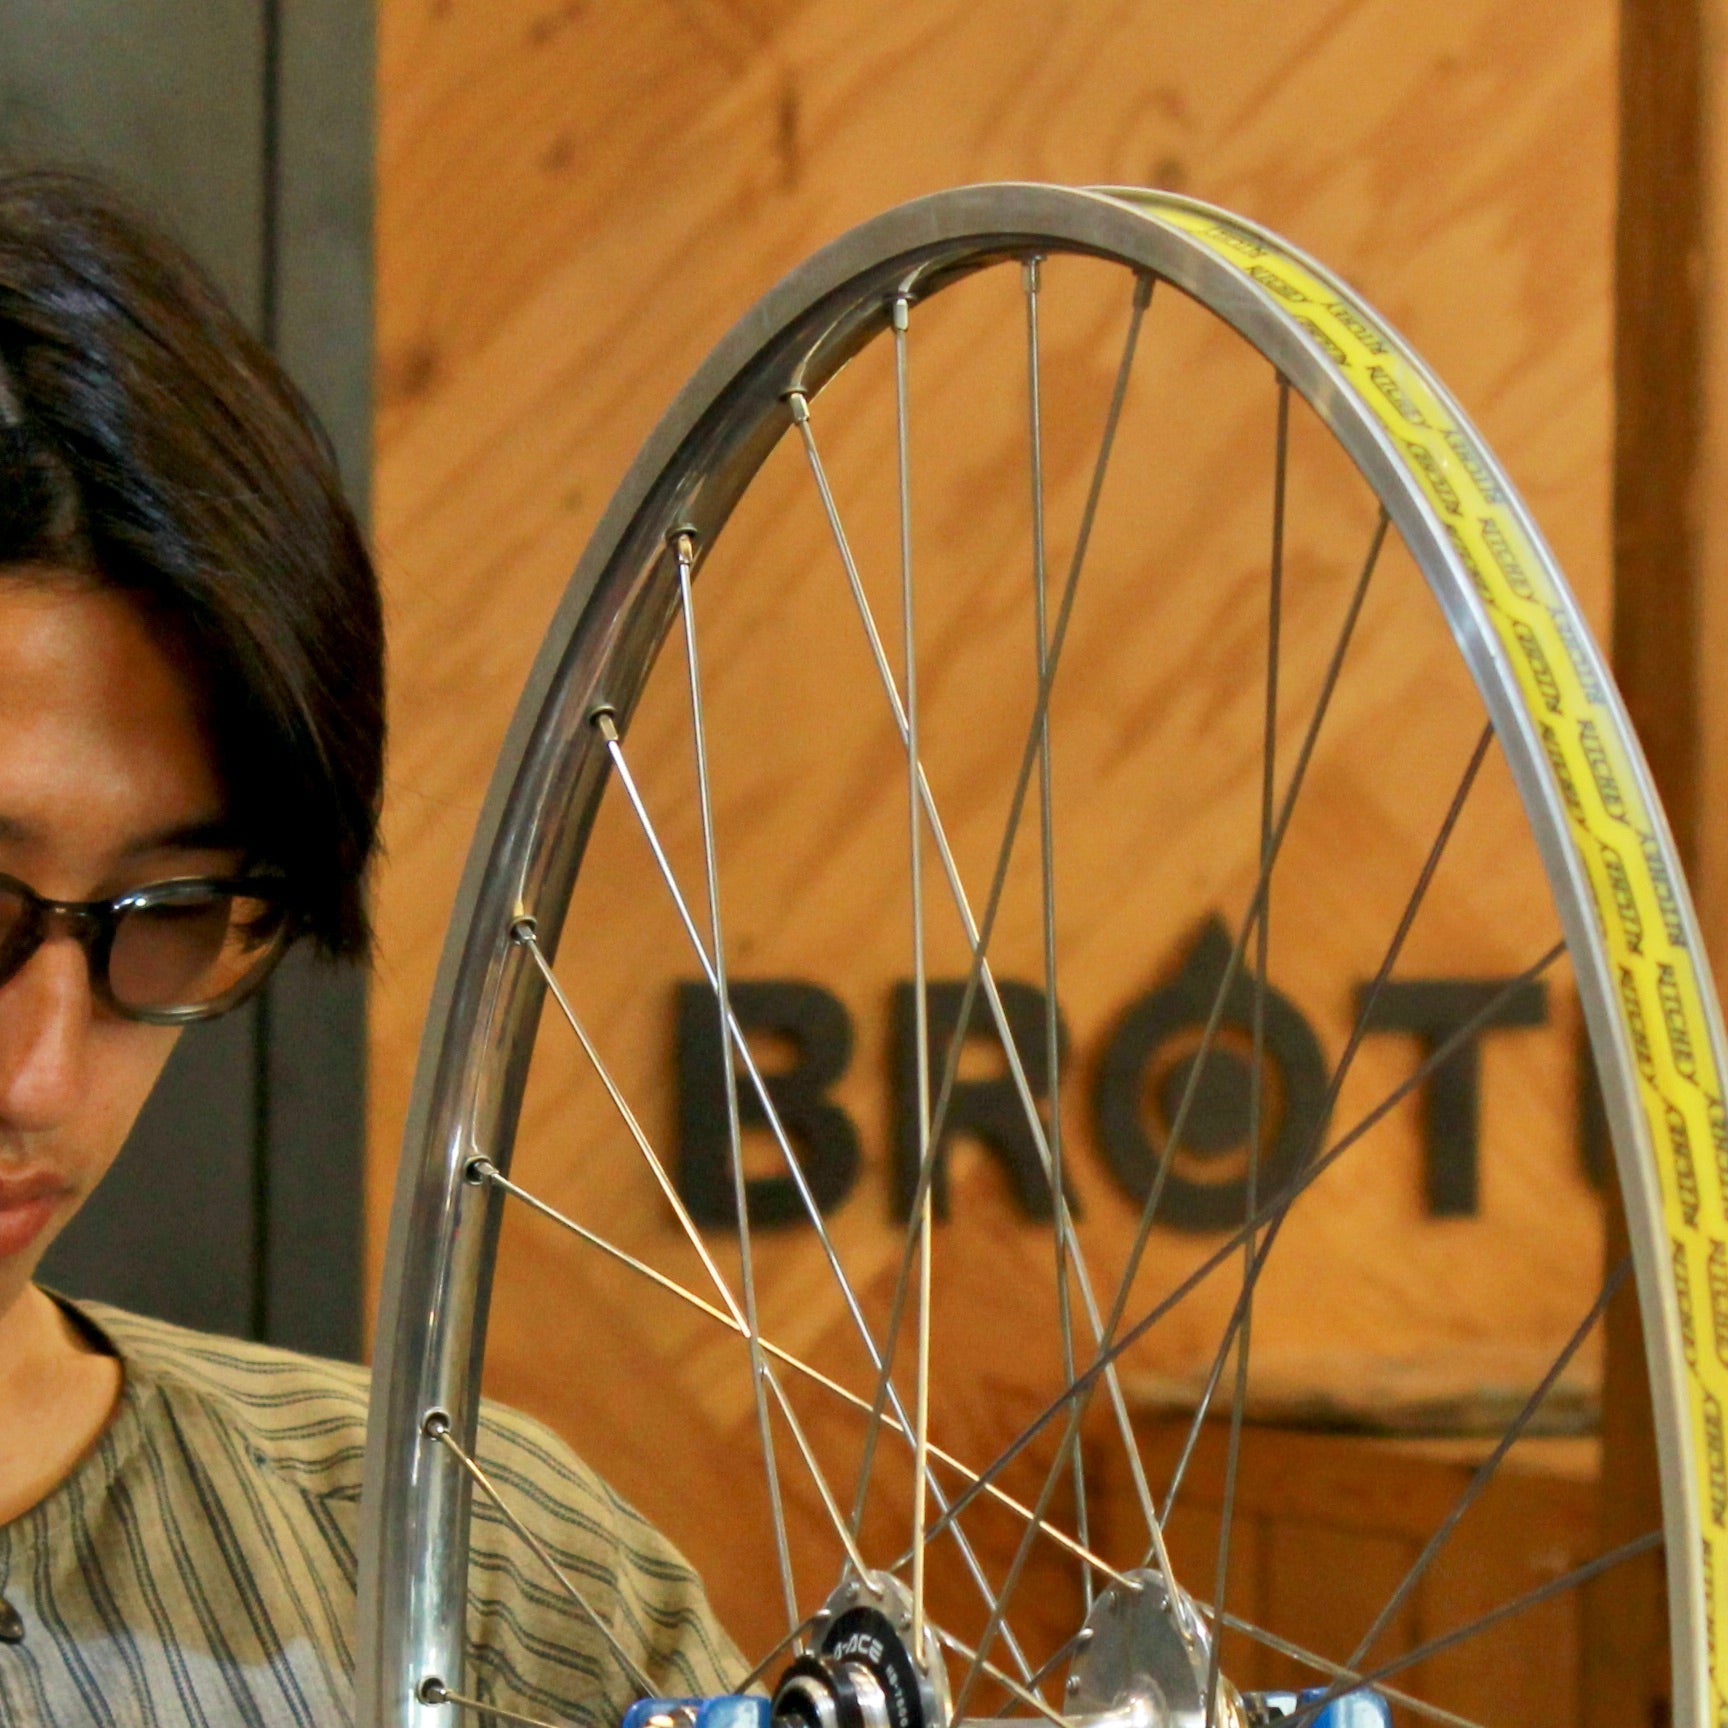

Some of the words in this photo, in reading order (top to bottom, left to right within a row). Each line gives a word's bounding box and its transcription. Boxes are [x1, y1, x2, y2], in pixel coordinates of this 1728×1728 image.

[1368, 367, 1431, 428] RITCHEY
[1479, 517, 1536, 602] RITCHEY
[1578, 719, 1629, 825] RITCHEY
[1656, 961, 1699, 1087] RITCHEY
[1661, 1098, 1699, 1232] RITCHEY
